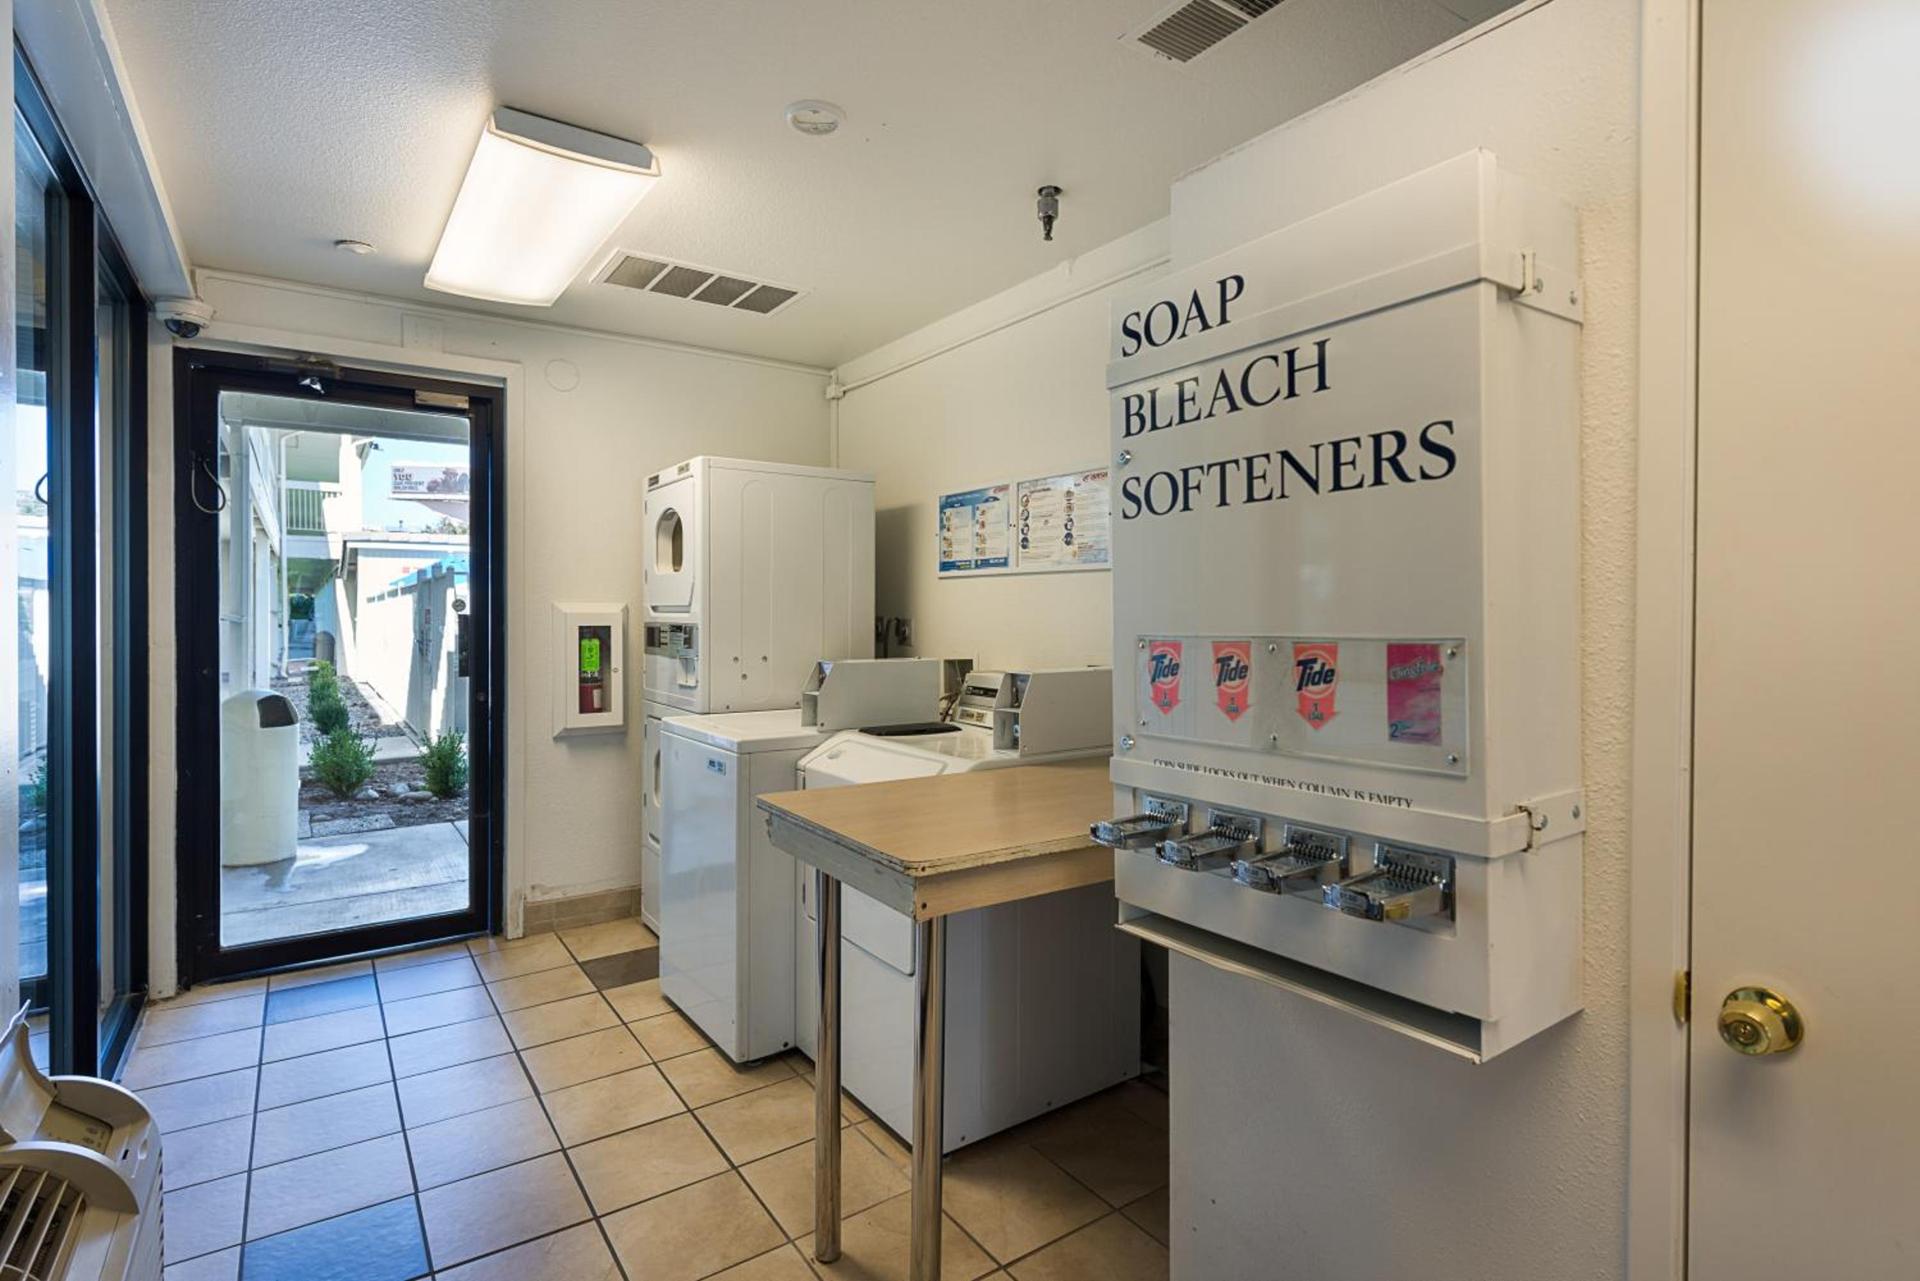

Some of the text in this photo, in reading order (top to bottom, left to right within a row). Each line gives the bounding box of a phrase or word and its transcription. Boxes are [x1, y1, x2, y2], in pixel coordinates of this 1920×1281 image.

[1121, 274, 1244, 357] SOAP
[1122, 338, 1331, 438] BLEACH
[1121, 420, 1457, 519] SOFTENERS
[1150, 653, 1180, 685] Tide
[1215, 655, 1249, 687] Tide
[1296, 657, 1336, 692] Tide
[1153, 758, 1175, 768] COIN
[1203, 765, 1236, 779] LOCKS
[1237, 770, 1260, 782] OUT
[1262, 774, 1296, 789] WHEN
[1298, 780, 1351, 798] COLUMN
[1354, 790, 1365, 801] IS
[1368, 792, 1414, 809] EMPTY
